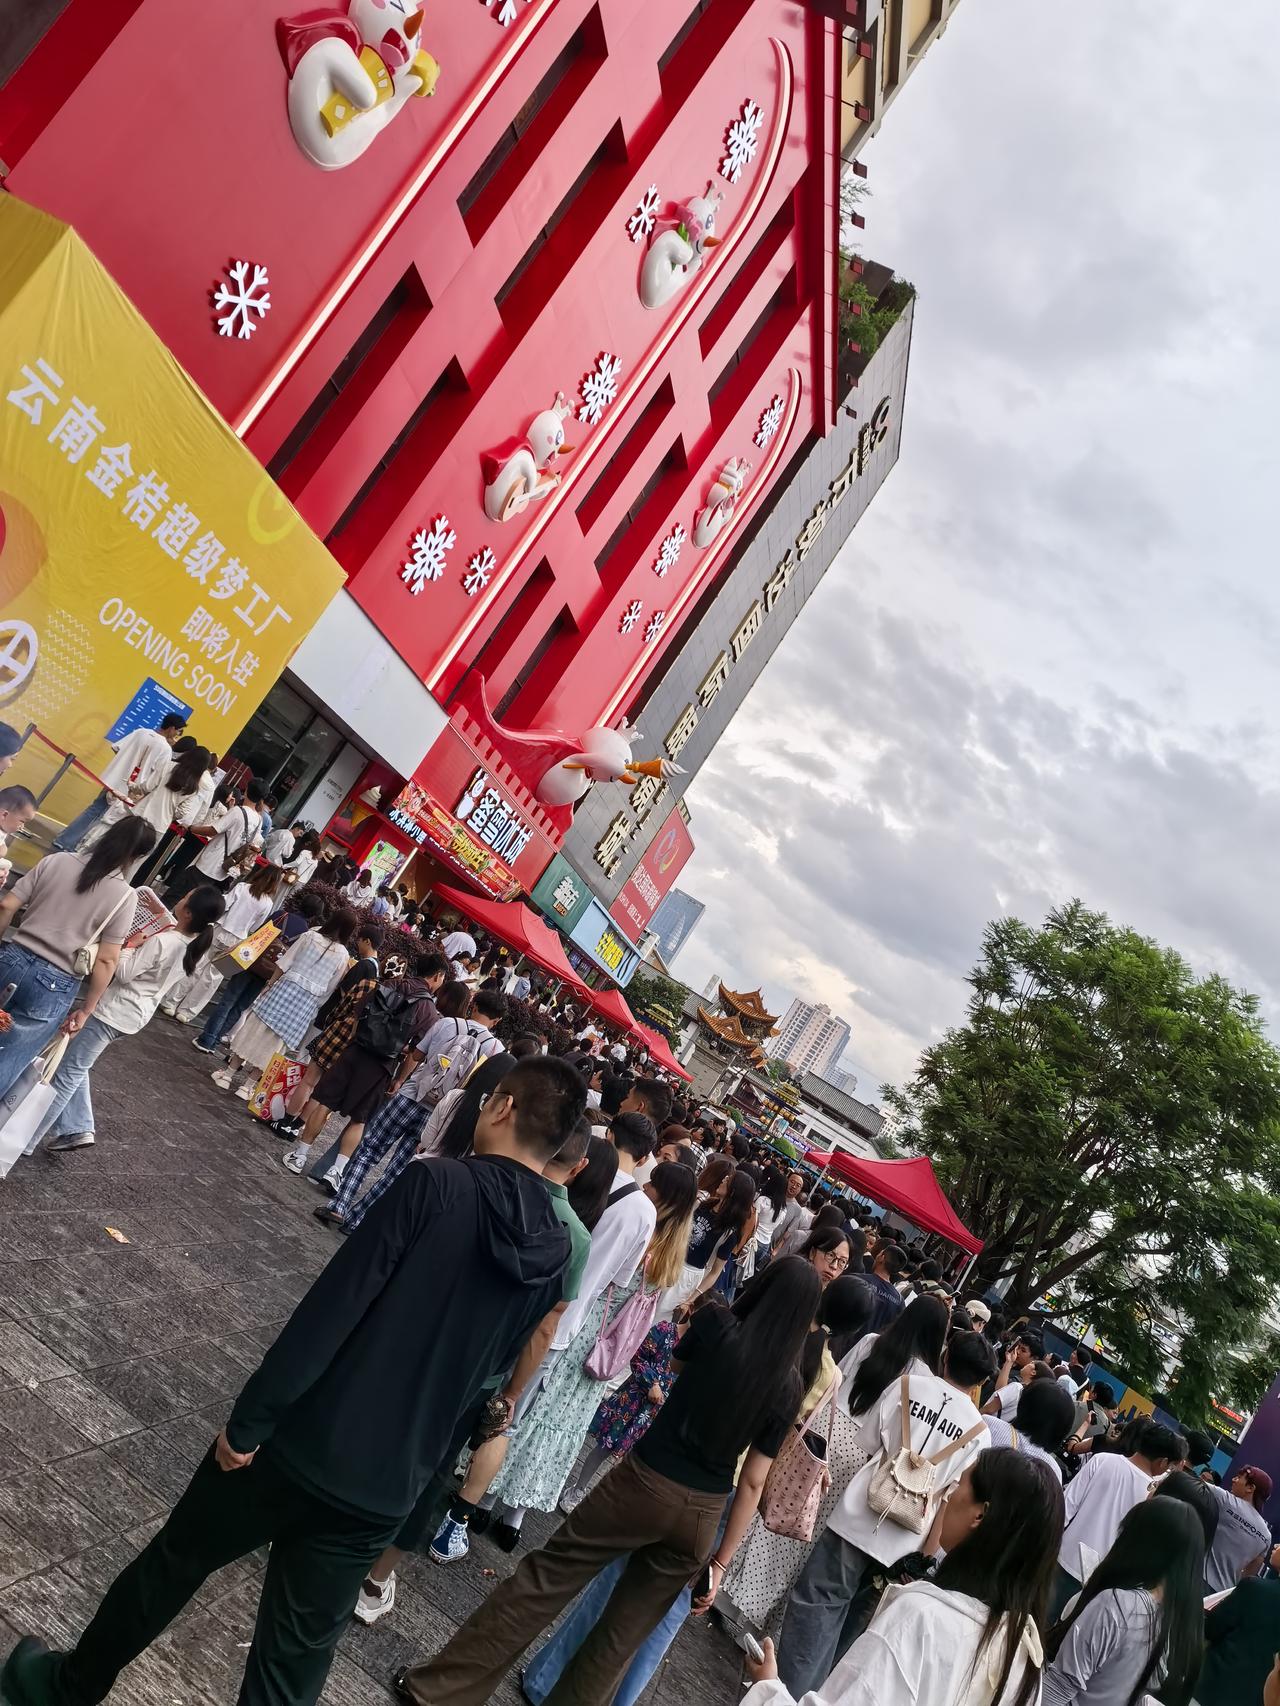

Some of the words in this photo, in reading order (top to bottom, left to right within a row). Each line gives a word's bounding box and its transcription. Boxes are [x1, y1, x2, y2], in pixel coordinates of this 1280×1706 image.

[6, 357, 292, 637] 云南金桔超级梦工厂
[99, 597, 188, 678] OPENING
[183, 664, 238, 717] SOON
[180, 605, 261, 687] 即将入驻
[466, 787, 534, 868] 蜜雪冰城
[908, 1399, 938, 1428] TEAM
[937, 1425, 964, 1449] AUR
